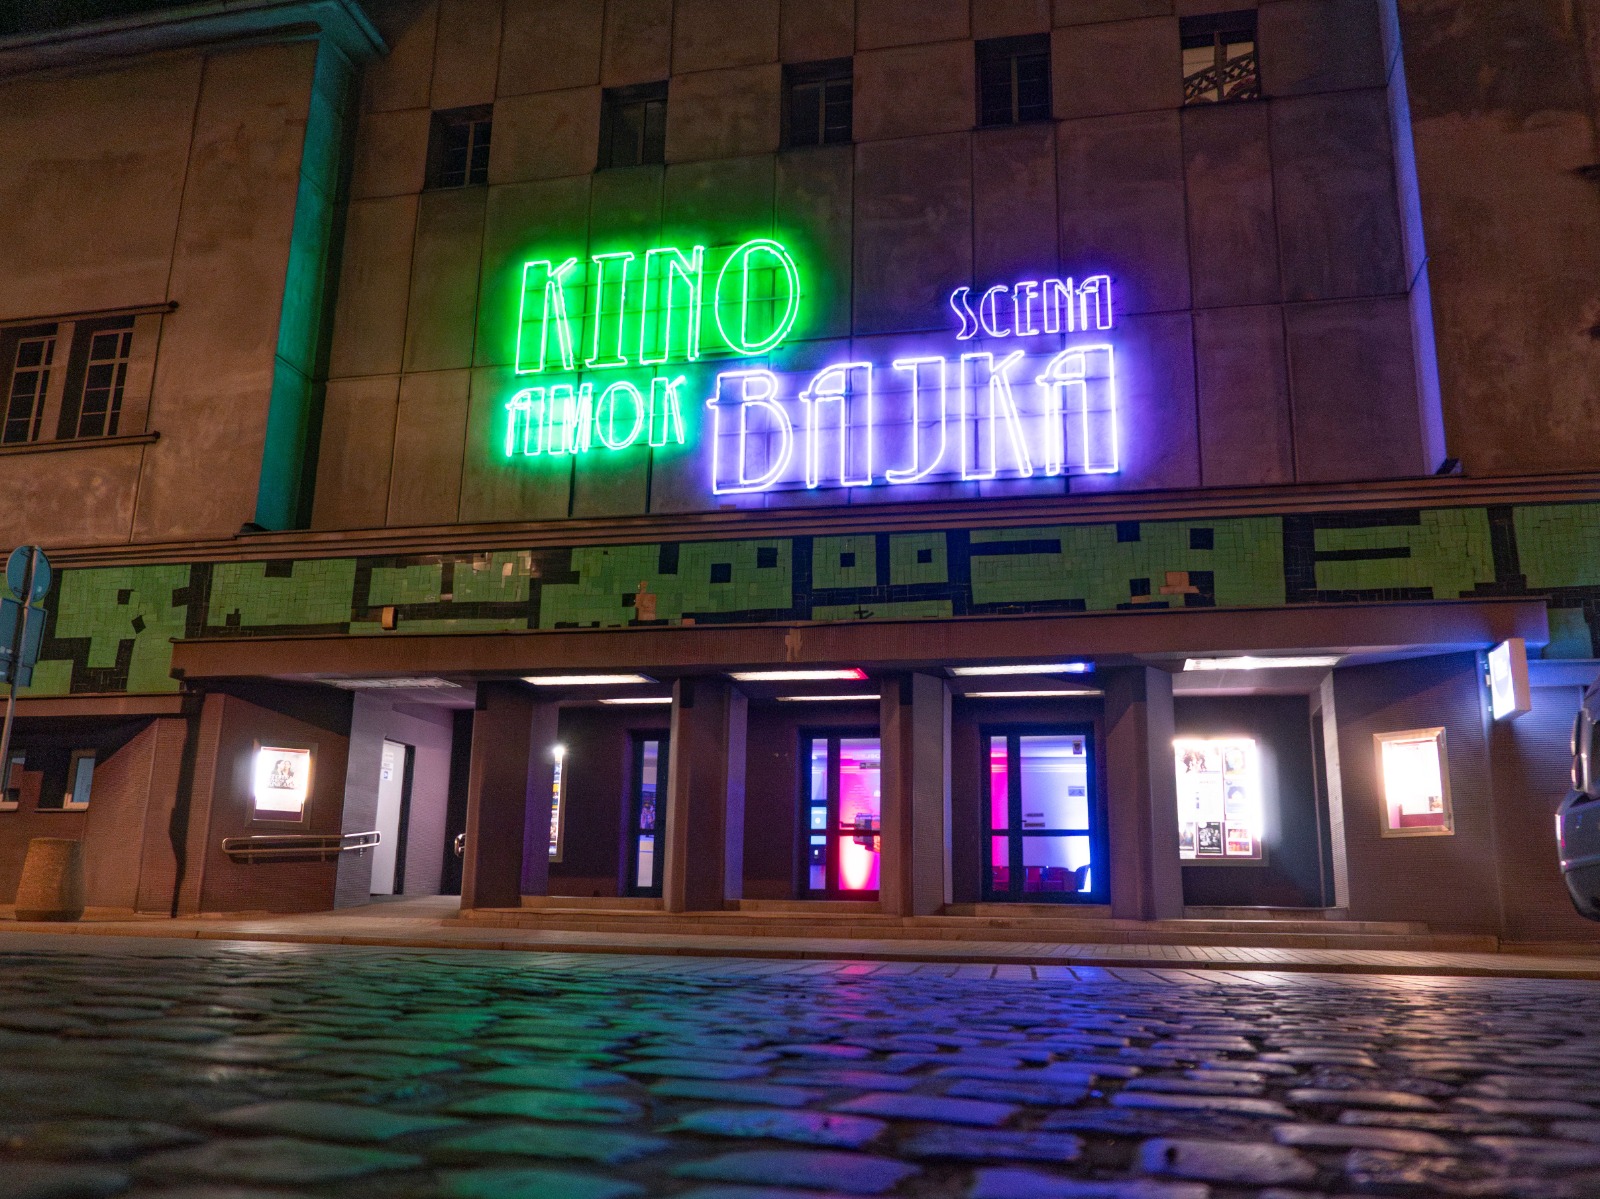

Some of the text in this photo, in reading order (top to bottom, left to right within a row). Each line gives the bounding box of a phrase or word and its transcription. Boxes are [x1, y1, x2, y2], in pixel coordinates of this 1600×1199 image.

[515, 238, 801, 375] KINO
[949, 274, 1113, 340] SCENA
[505, 375, 687, 457] AMOK
[706, 344, 1120, 496] BAJKA
